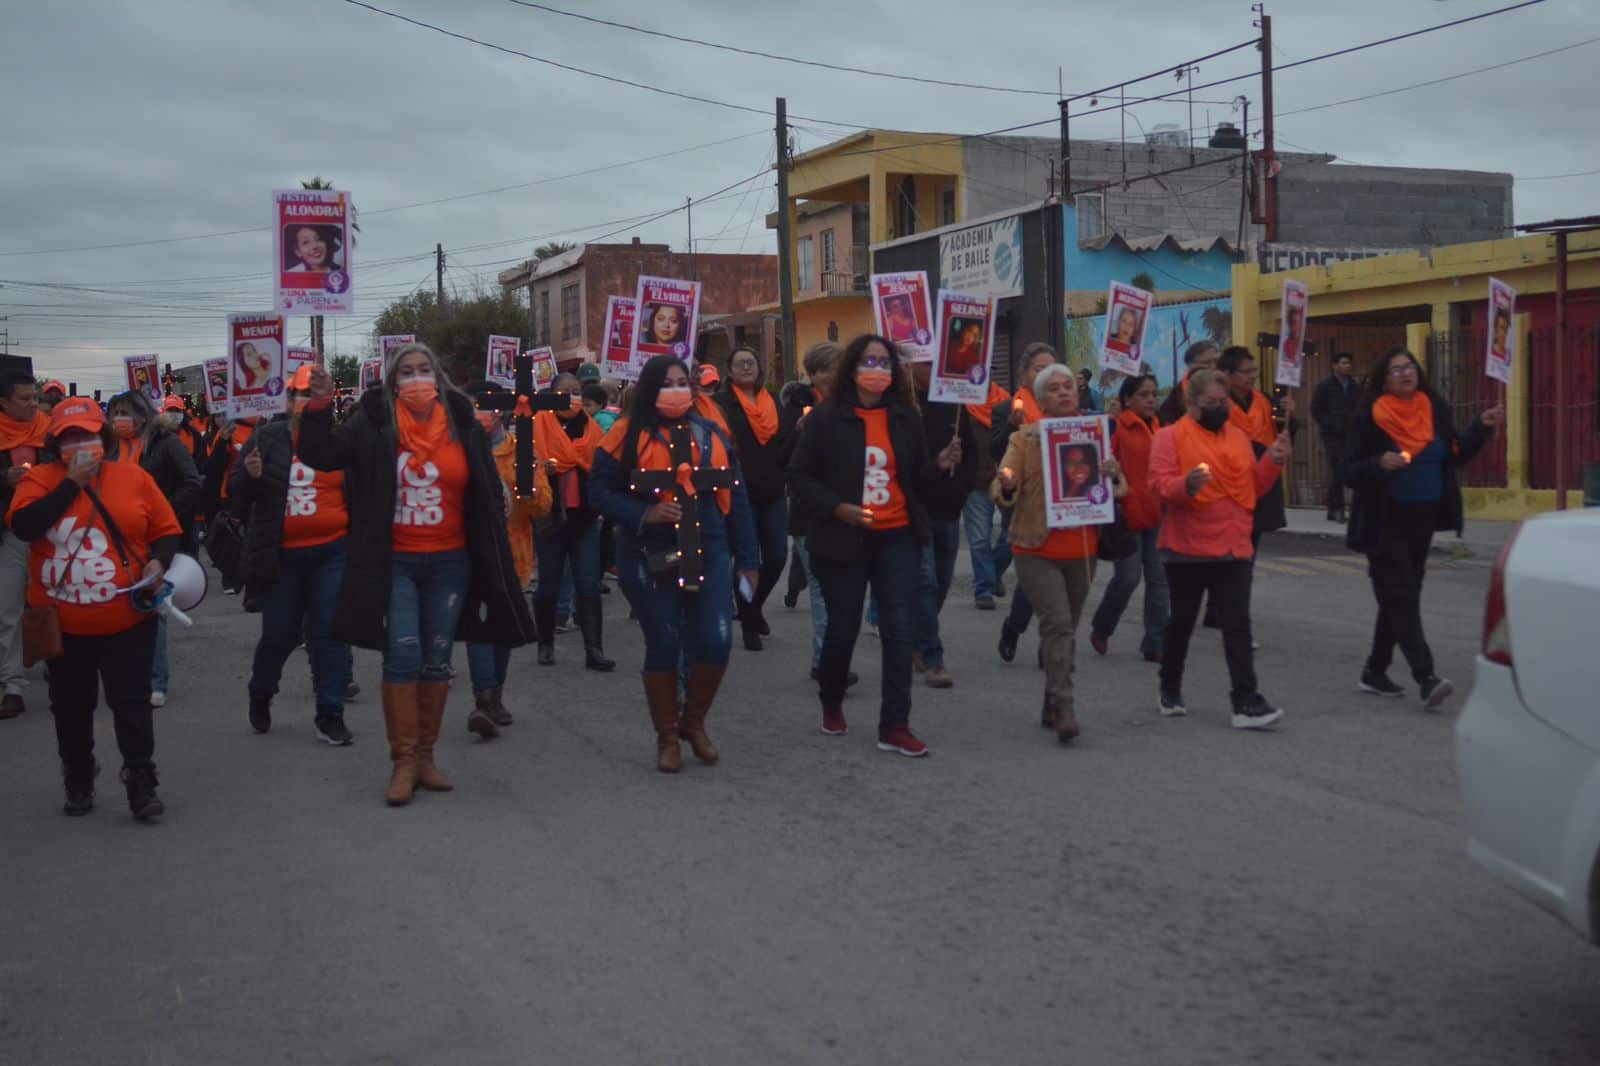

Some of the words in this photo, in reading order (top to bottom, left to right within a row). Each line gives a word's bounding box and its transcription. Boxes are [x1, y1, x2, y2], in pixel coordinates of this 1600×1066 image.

[285, 204, 344, 217] ALONDRA!
[950, 227, 993, 253] ACADEMIA
[951, 255, 962, 272] DE
[965, 247, 990, 269] BAILE
[241, 325, 278, 337] WENDY!
[47, 516, 108, 559] Yo
[41, 557, 117, 585] me
